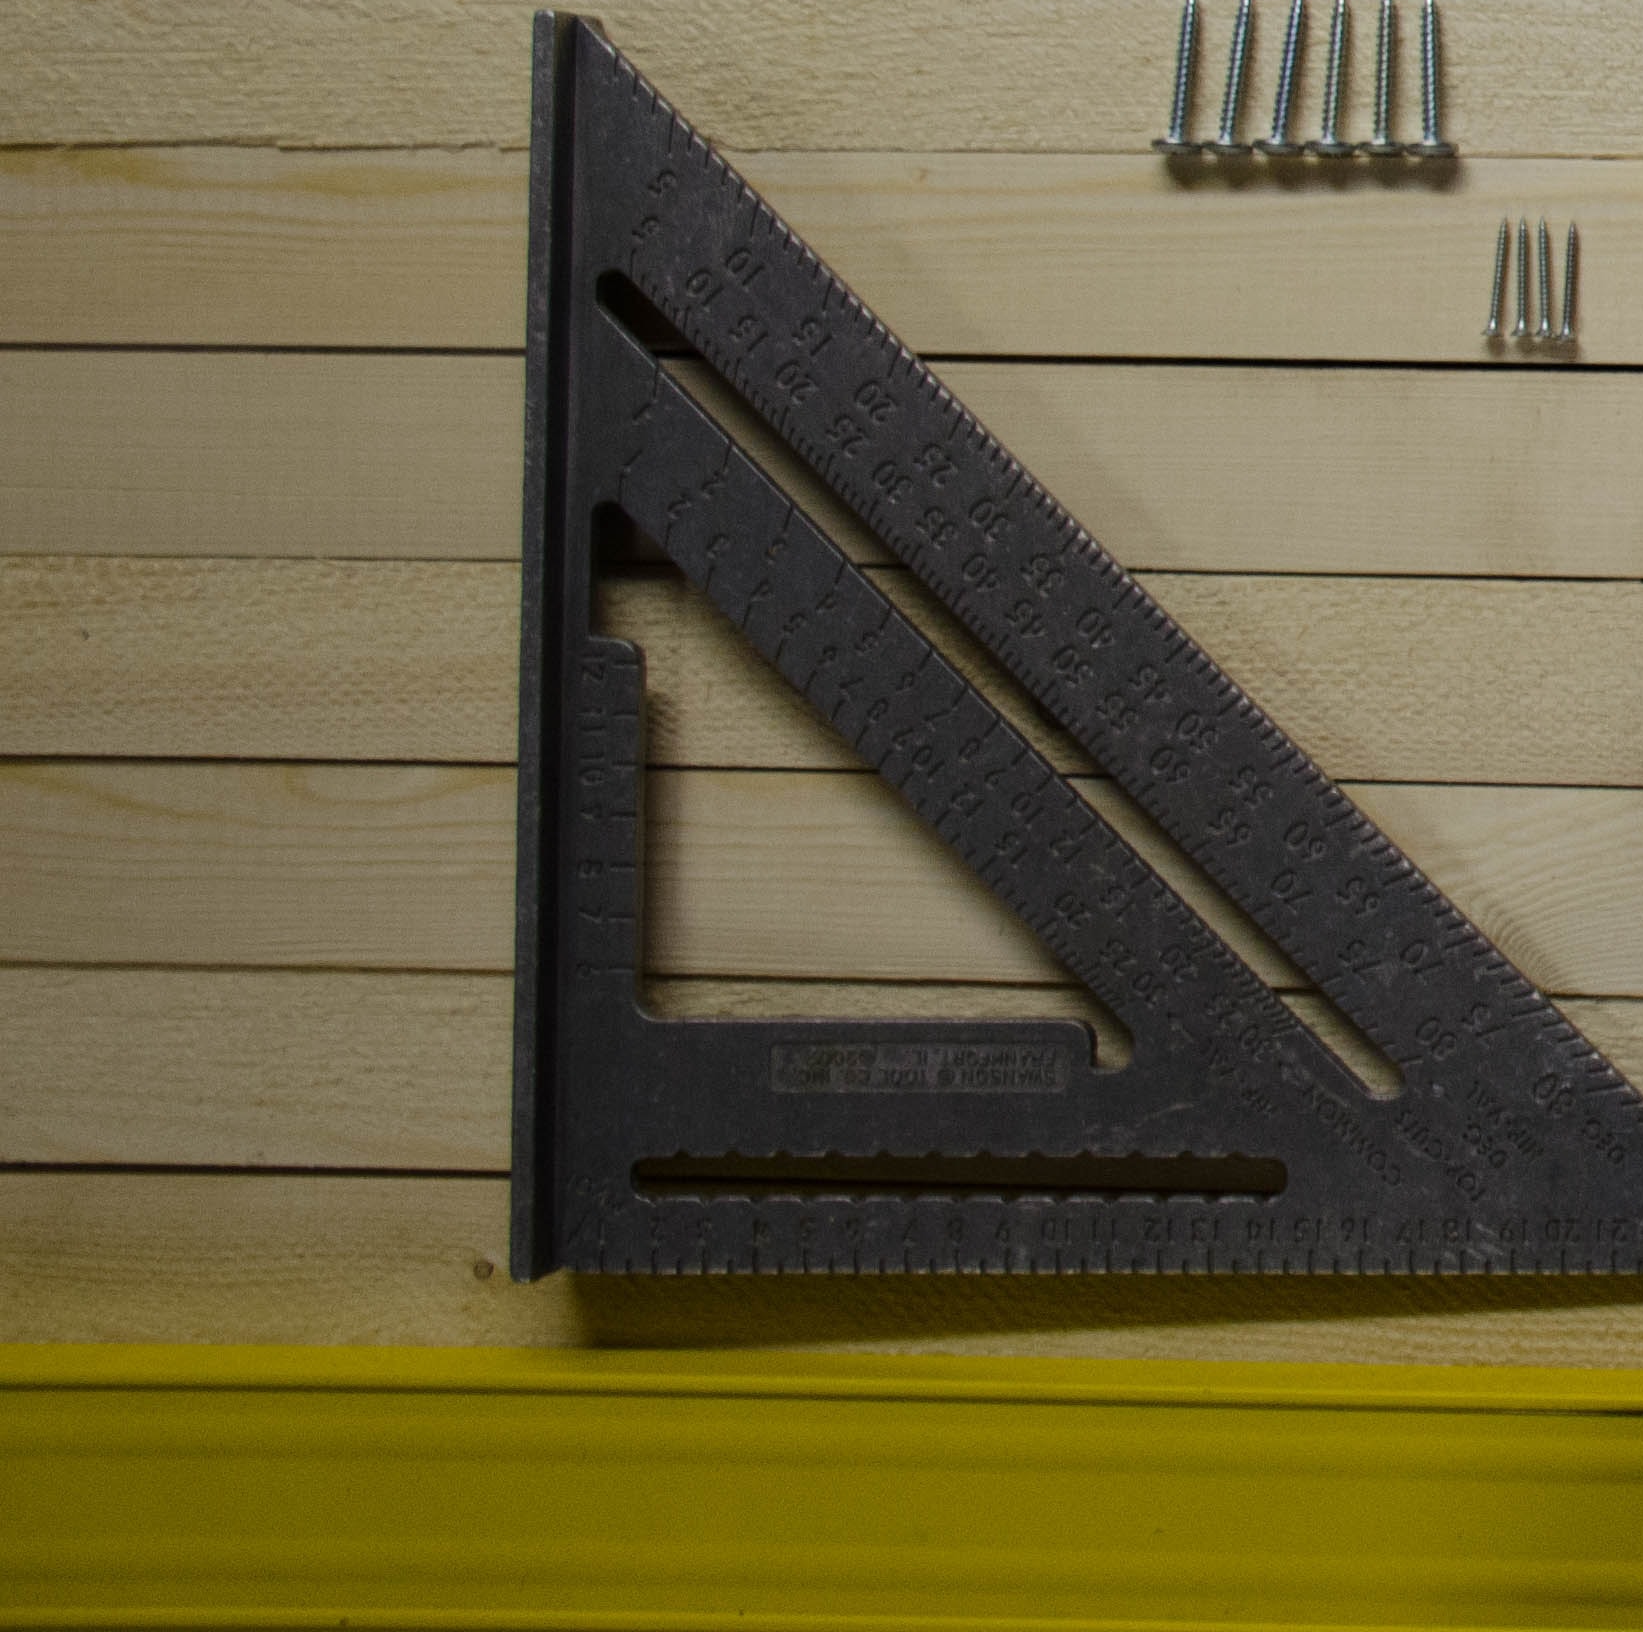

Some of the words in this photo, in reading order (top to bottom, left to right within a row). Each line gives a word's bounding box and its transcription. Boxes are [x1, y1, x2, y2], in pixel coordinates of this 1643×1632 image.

[648, 169, 678, 199] 5
[632, 215, 661, 240] 5
[686, 268, 724, 308] 10
[726, 247, 764, 287] 10
[730, 315, 769, 354] 15
[793, 317, 833, 356] 15
[775, 360, 820, 404] 20
[853, 380, 898, 424] 20
[826, 415, 867, 459] 25
[872, 460, 914, 505] 30
[914, 443, 959, 488] 25
[915, 505, 959, 551] 35
[968, 498, 1011, 543] 30
[961, 552, 1002, 593] 40
[1023, 552, 1065, 598] 35
[1005, 599, 1047, 640] 45
[1076, 607, 1115, 649] 40
[1051, 644, 1095, 687] 50
[1129, 665, 1171, 706] 45
[1097, 693, 1141, 735] 55
[1175, 711, 1219, 754] 50
[1149, 745, 1193, 785] 60
[1229, 765, 1274, 809] 55
[1207, 808, 1254, 849] 65
[1282, 821, 1327, 861] 60
[1271, 871, 1313, 913] 70
[1337, 876, 1381, 917] 65
[1337, 937, 1380, 983] 75
[1401, 938, 1443, 983] 70
[1414, 1016, 1458, 1062] 80
[1461, 1002, 1508, 1046] 75
[1532, 1072, 1576, 1118] 80
